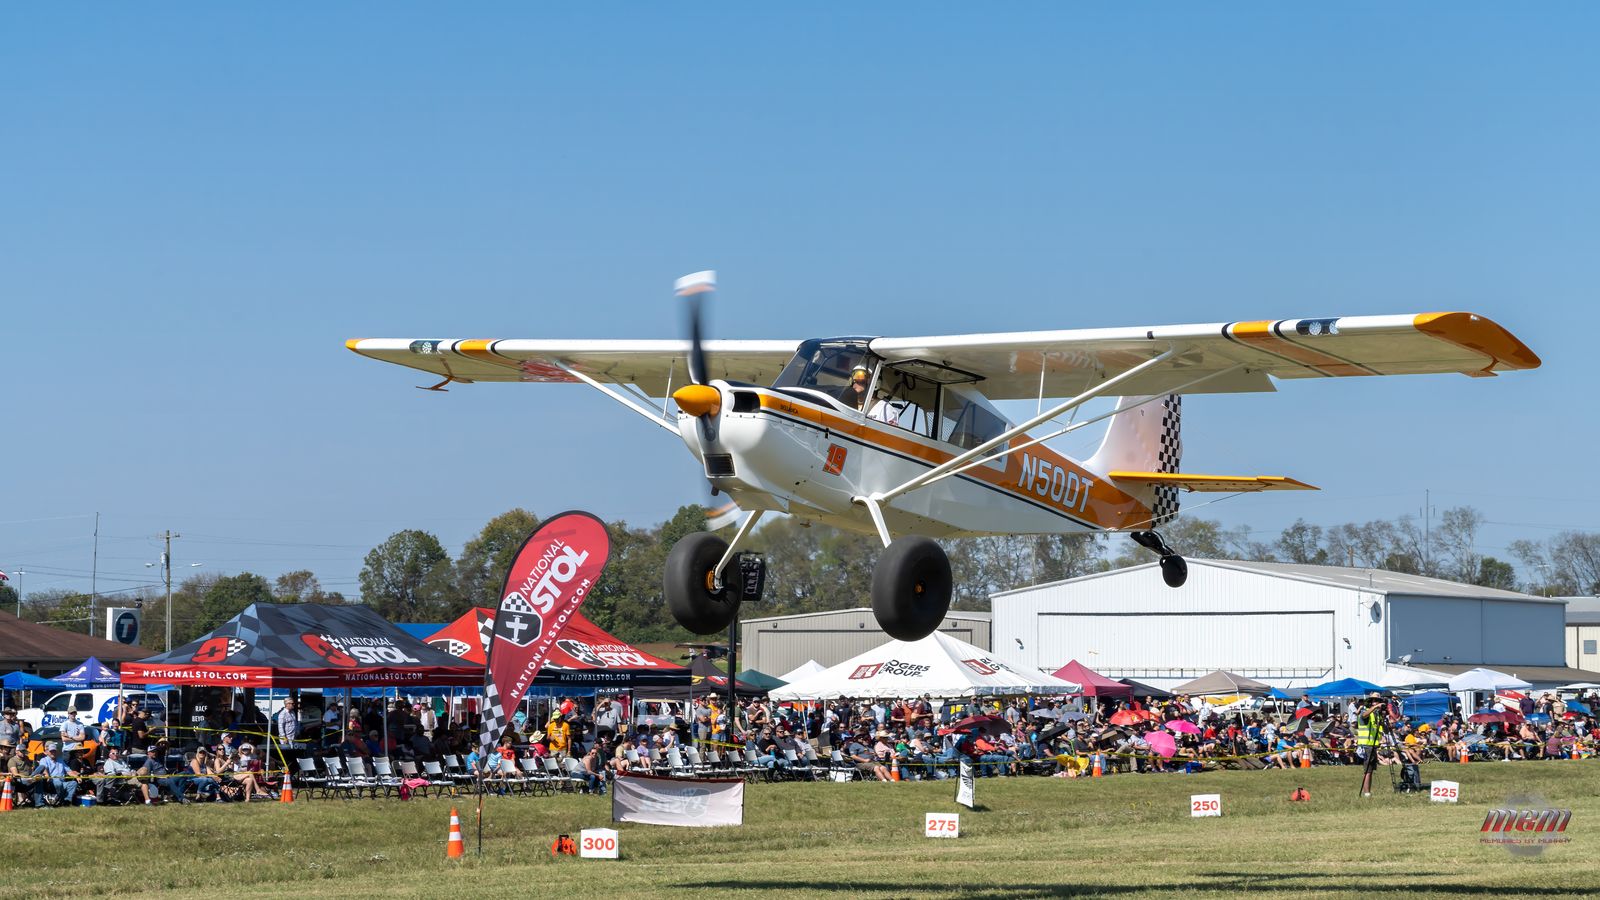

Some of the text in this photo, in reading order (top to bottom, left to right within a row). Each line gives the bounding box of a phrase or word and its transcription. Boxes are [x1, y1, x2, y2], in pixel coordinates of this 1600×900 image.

[1017, 452, 1094, 513] N50DT
[520, 538, 565, 596] NATIONAL
[530, 545, 589, 614] STOL
[341, 637, 394, 646] NATIONAL
[510, 579, 590, 698] NATIONALSTOL.COM
[591, 644, 635, 652] NATIONAL
[350, 646, 420, 664] STOL
[598, 652, 657, 666] STOL
[143, 670, 247, 681] NATIONALSTOL.COM
[345, 672, 423, 681] NATIONALSTOL.COM
[560, 673, 631, 681] NATIONALSTOL.COM
[1433, 787, 1457, 798] 225
[1193, 800, 1219, 811] 250
[928, 819, 957, 831] 275
[583, 837, 615, 850] 300
